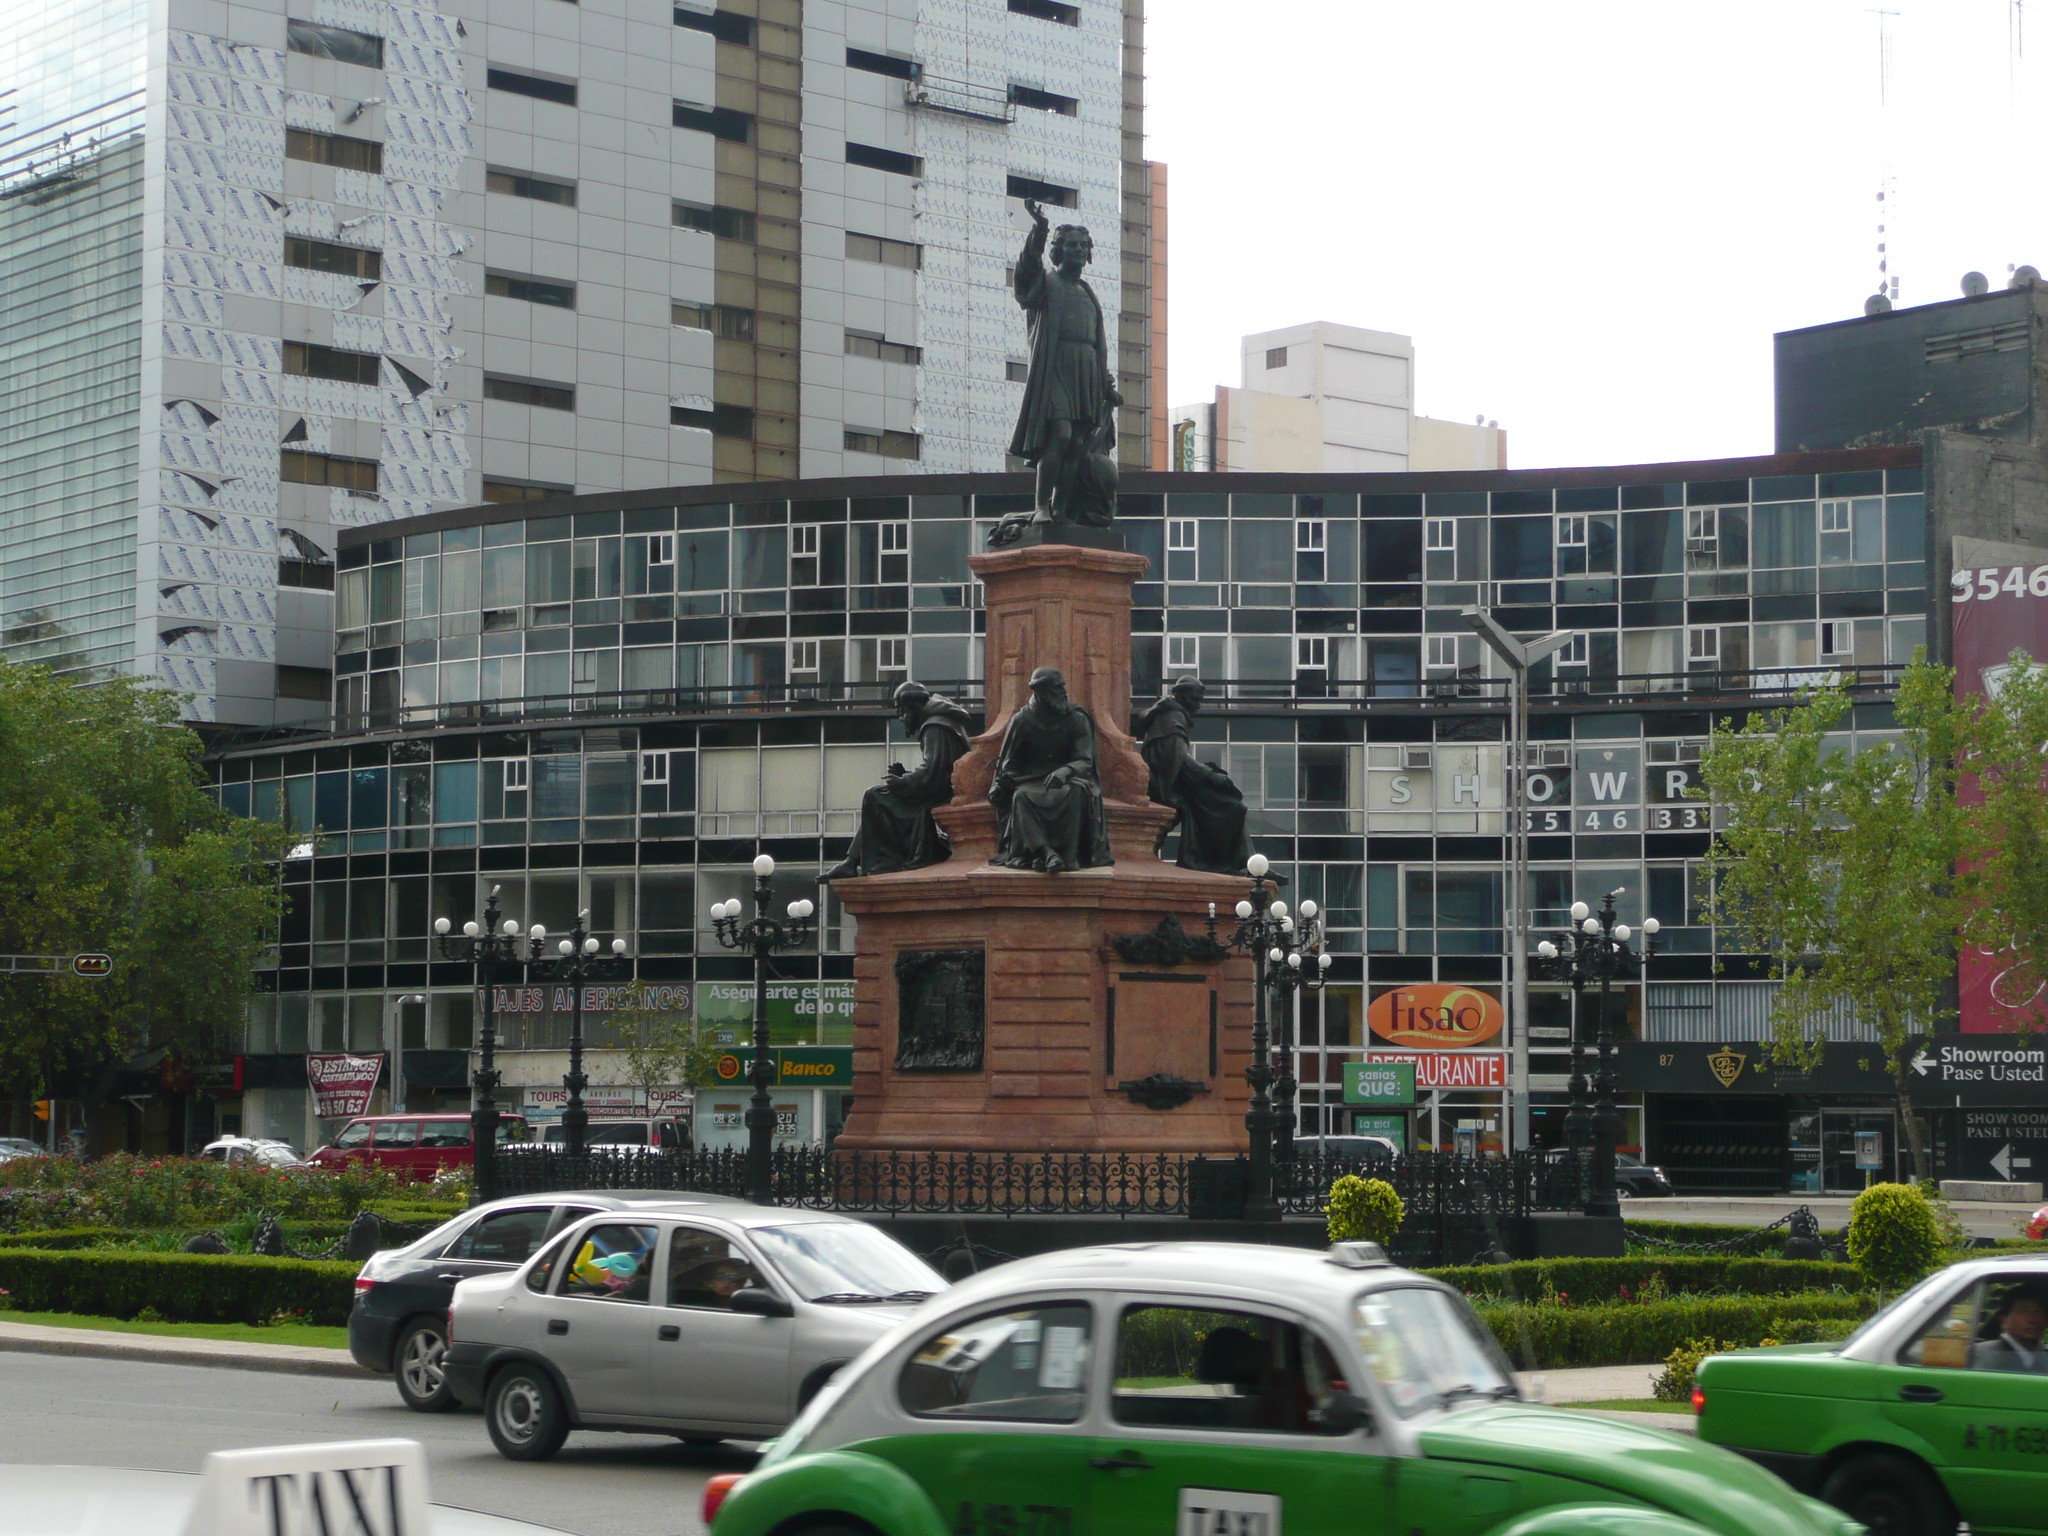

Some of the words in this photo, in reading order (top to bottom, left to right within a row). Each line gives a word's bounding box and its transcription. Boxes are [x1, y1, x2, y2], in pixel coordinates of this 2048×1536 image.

[709, 985, 799, 1002] Aseguarte
[794, 999, 816, 1014] de
[1659, 1054, 1674, 1066] 87
[1941, 1046, 2045, 1063] Showroom
[782, 1061, 835, 1076] Banco
[1942, 1065, 1984, 1081] Pase
[1990, 1065, 2044, 1081] Usted
[531, 1092, 567, 1102] TOURS
[1967, 1127, 2001, 1138] PASE
